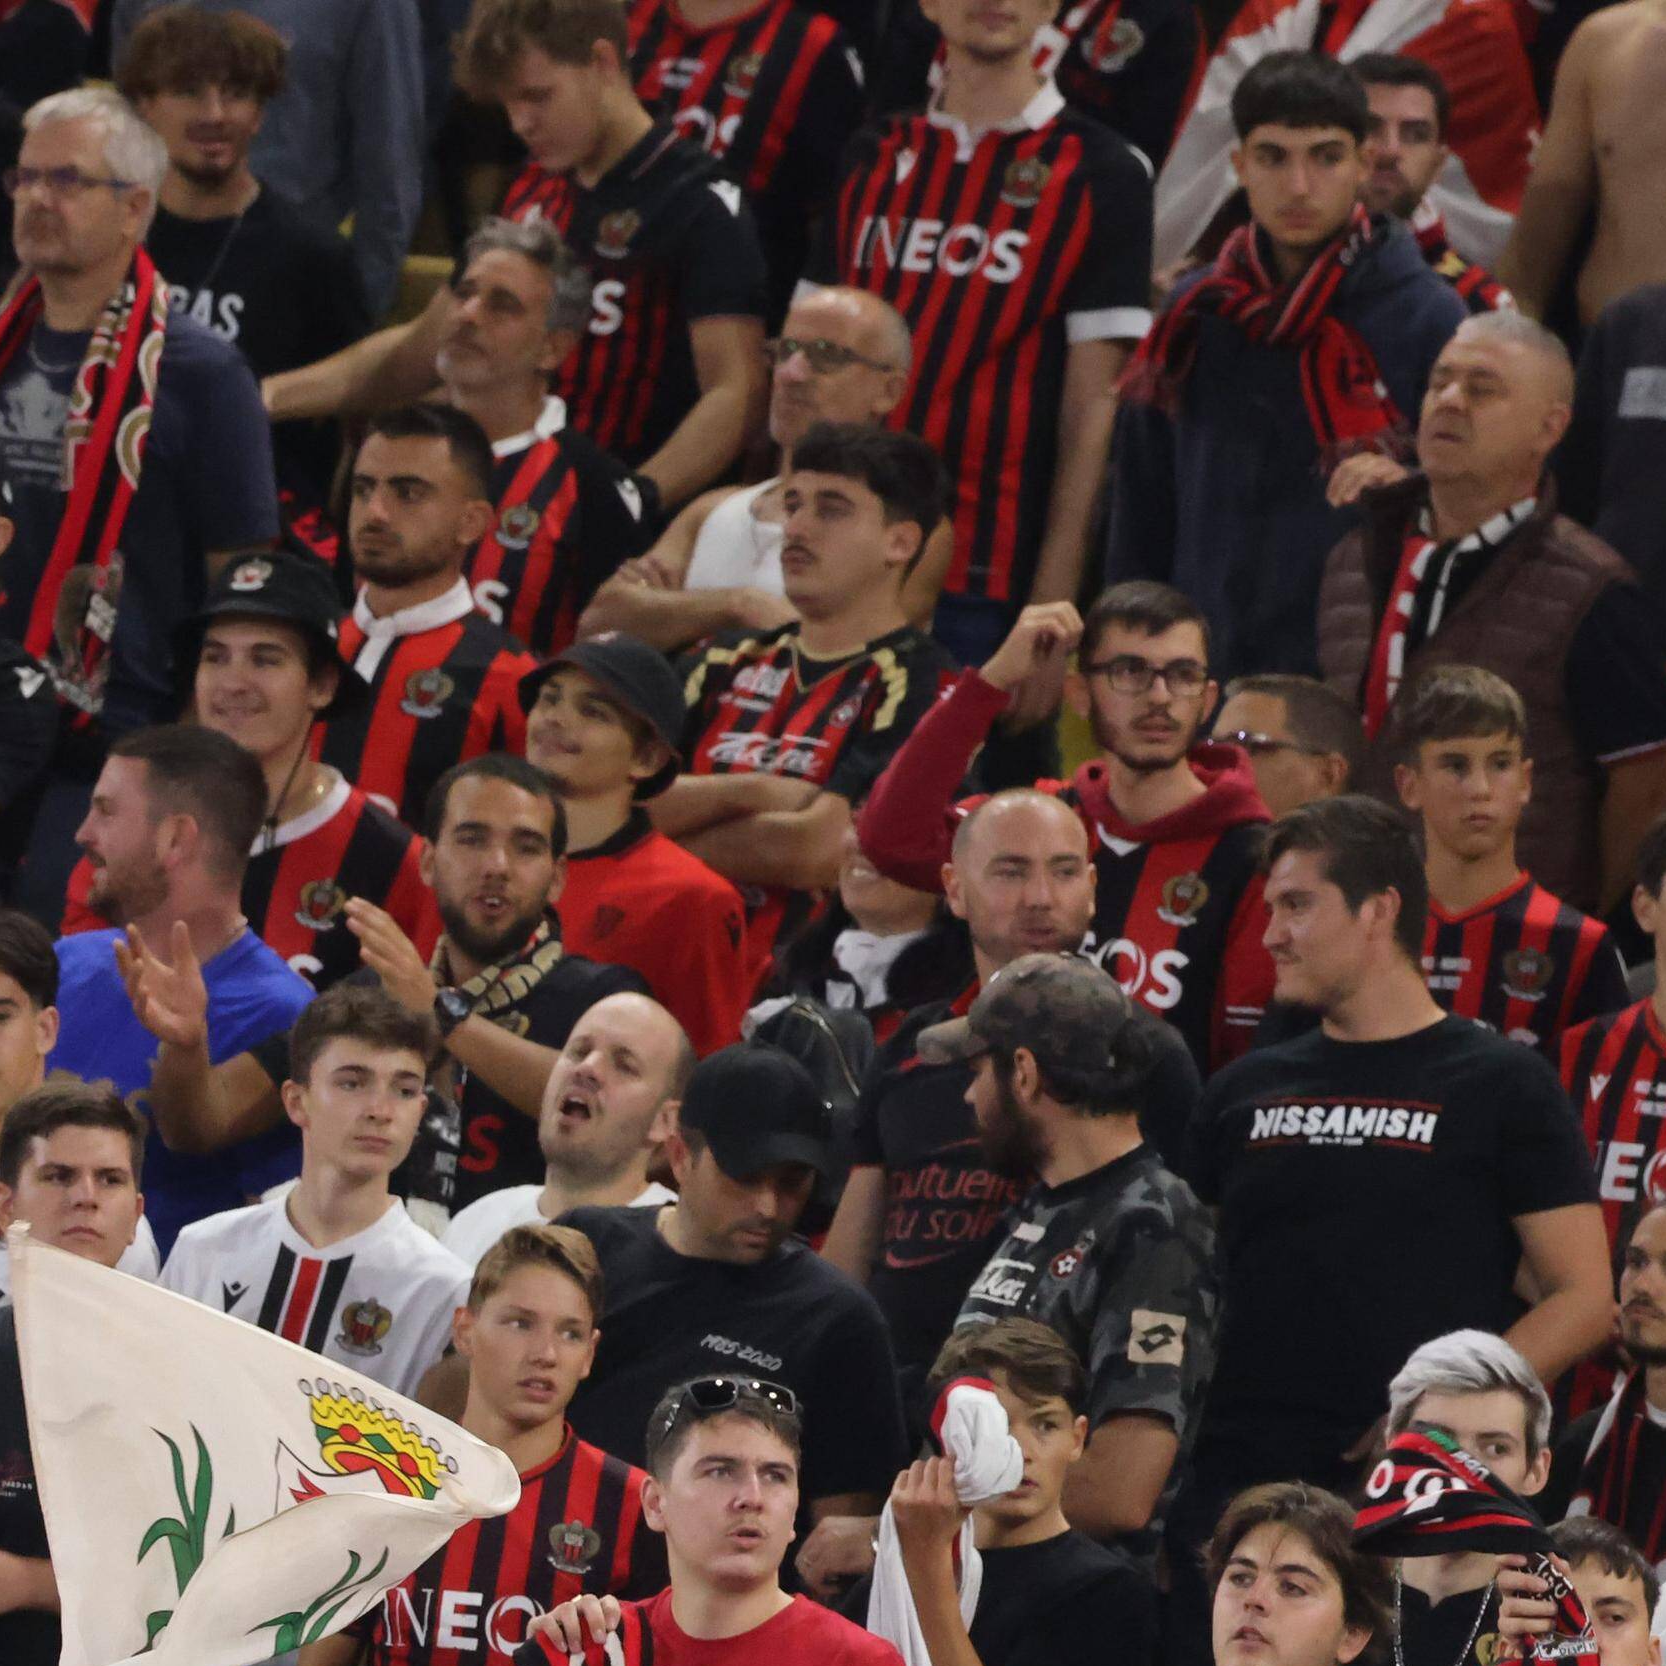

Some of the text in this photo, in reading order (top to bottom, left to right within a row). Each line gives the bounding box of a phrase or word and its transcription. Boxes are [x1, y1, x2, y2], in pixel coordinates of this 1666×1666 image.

[853, 211, 1030, 285] INEOS
[1252, 1105, 1439, 1146] NISSAMISH
[385, 1587, 543, 1658] INEO
